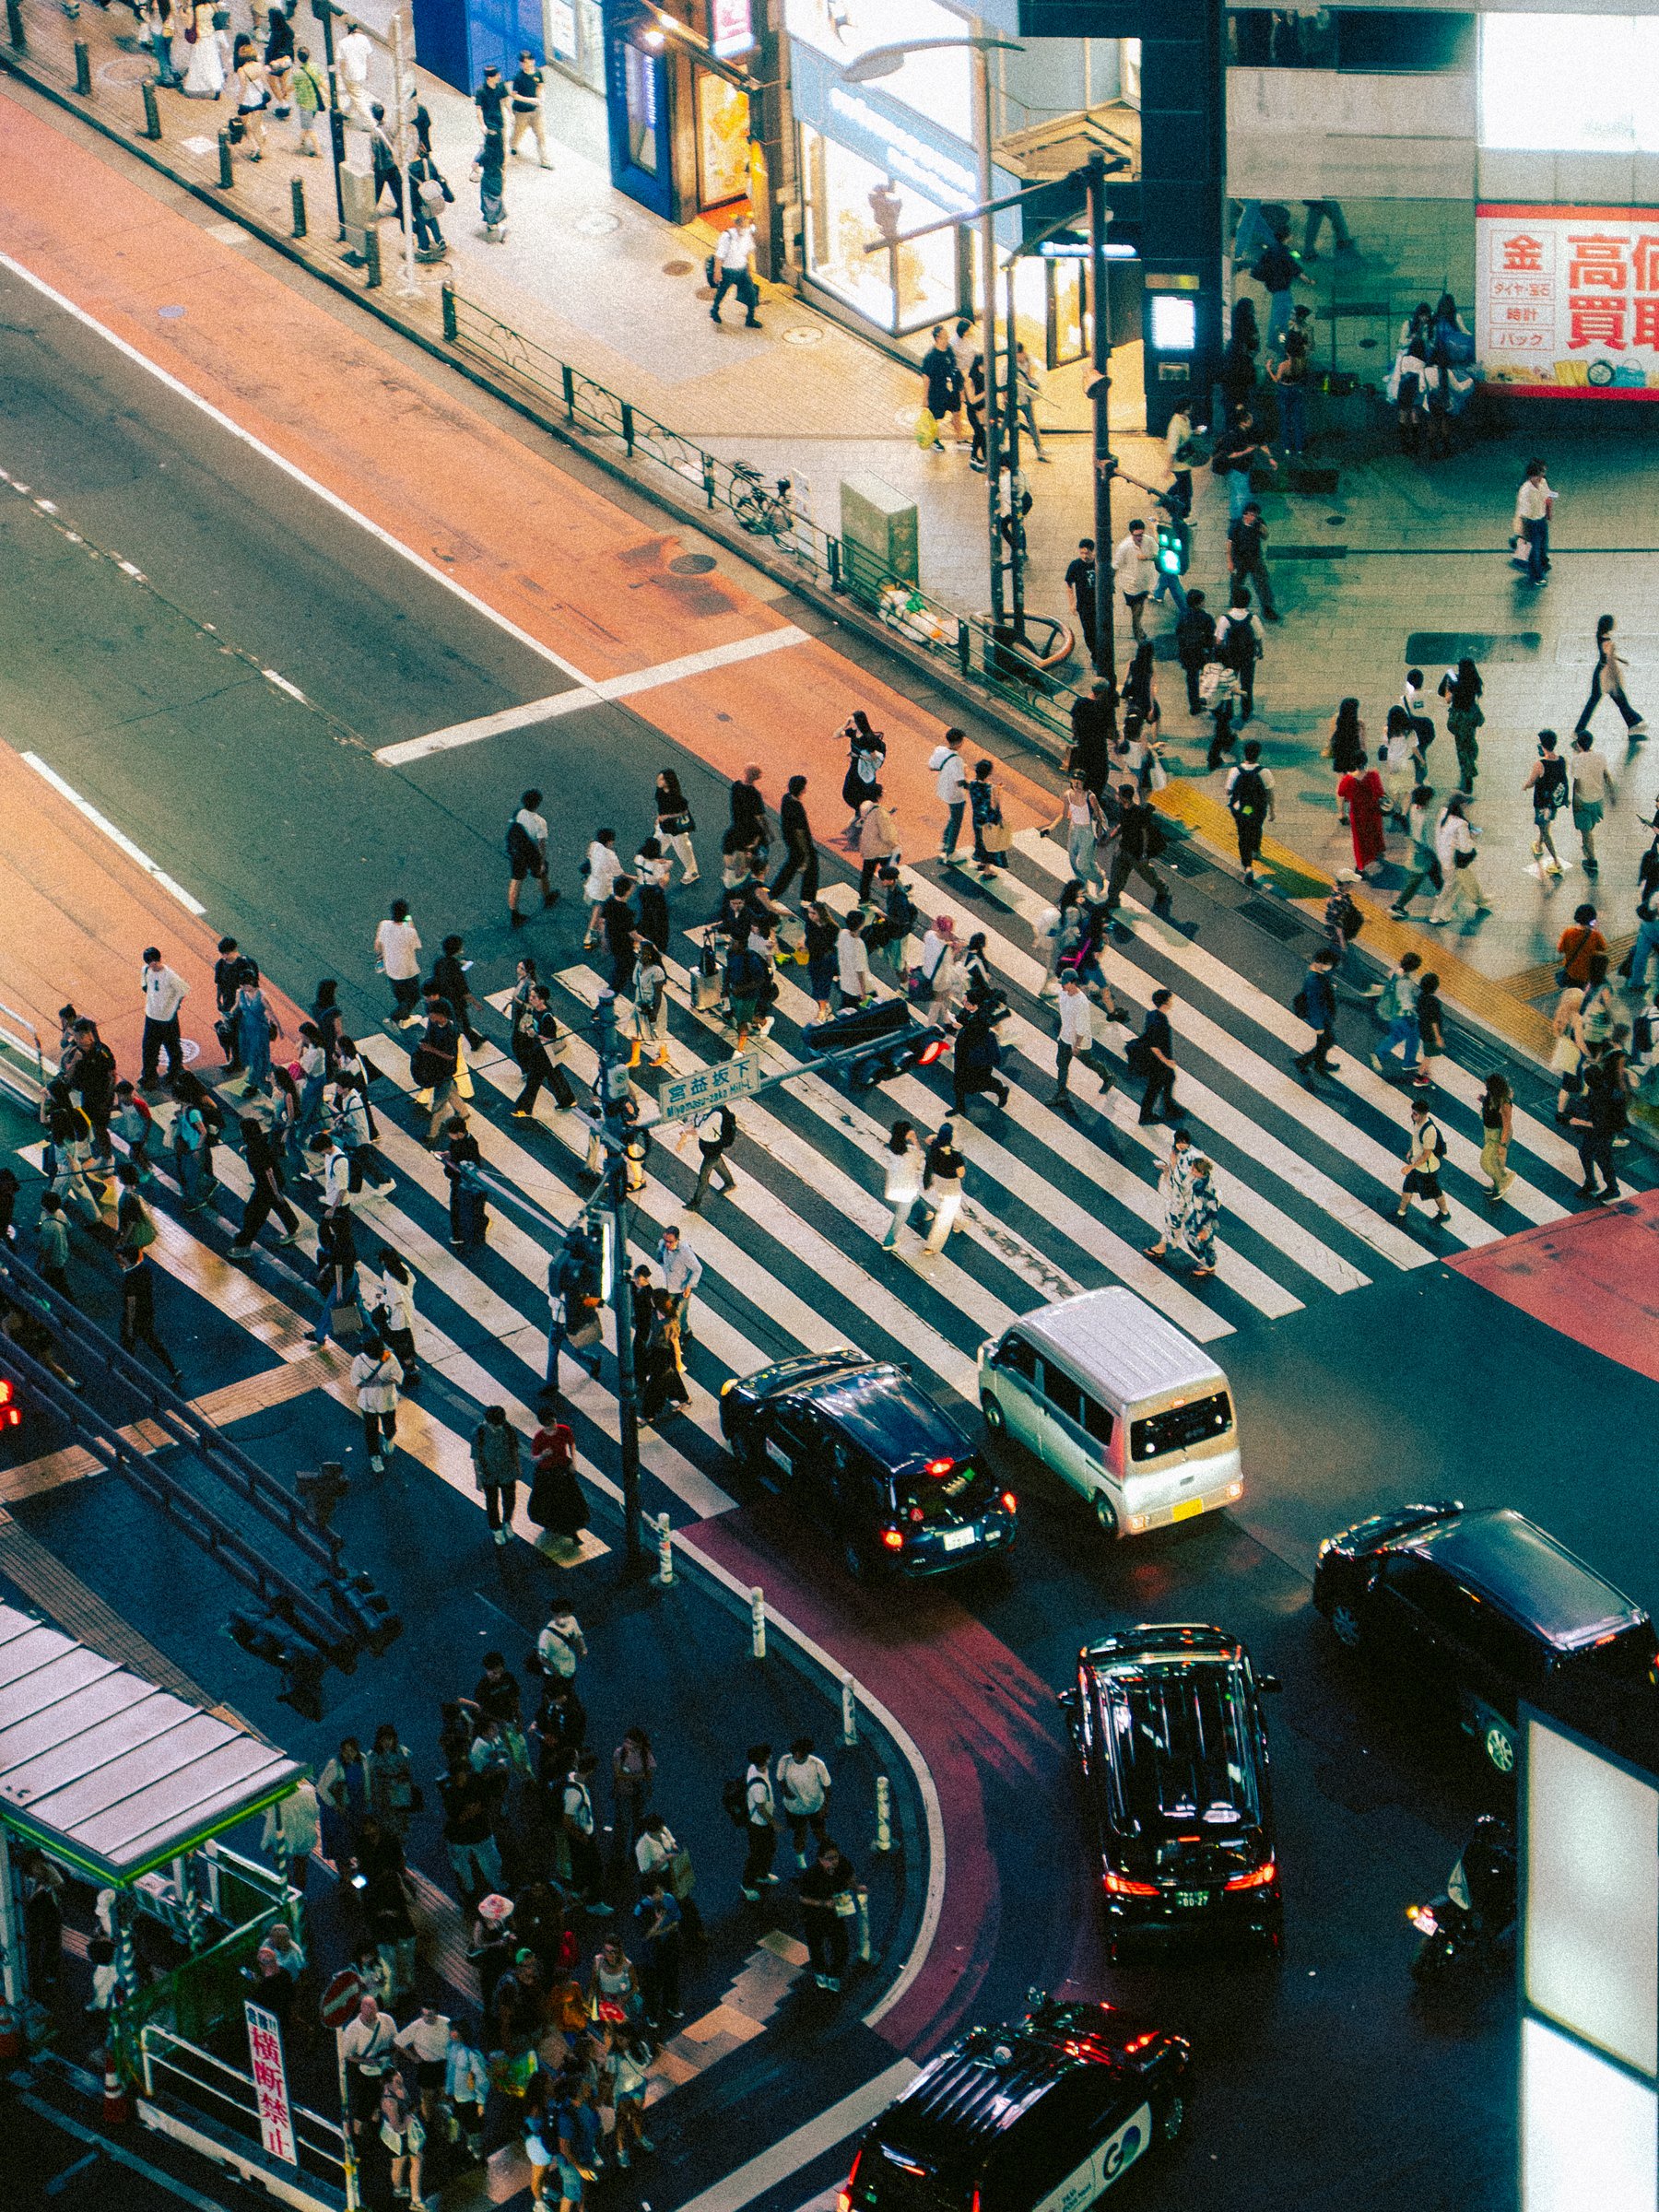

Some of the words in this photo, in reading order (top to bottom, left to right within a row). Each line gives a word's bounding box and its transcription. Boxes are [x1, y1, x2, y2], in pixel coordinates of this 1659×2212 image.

[1503, 235, 1543, 270] 金
[1506, 307, 1538, 322] 時計
[668, 1059, 751, 1103] 宮益坂下
[250, 2025, 294, 2162] 横断禁止
[1102, 2124, 1142, 2182] GO
